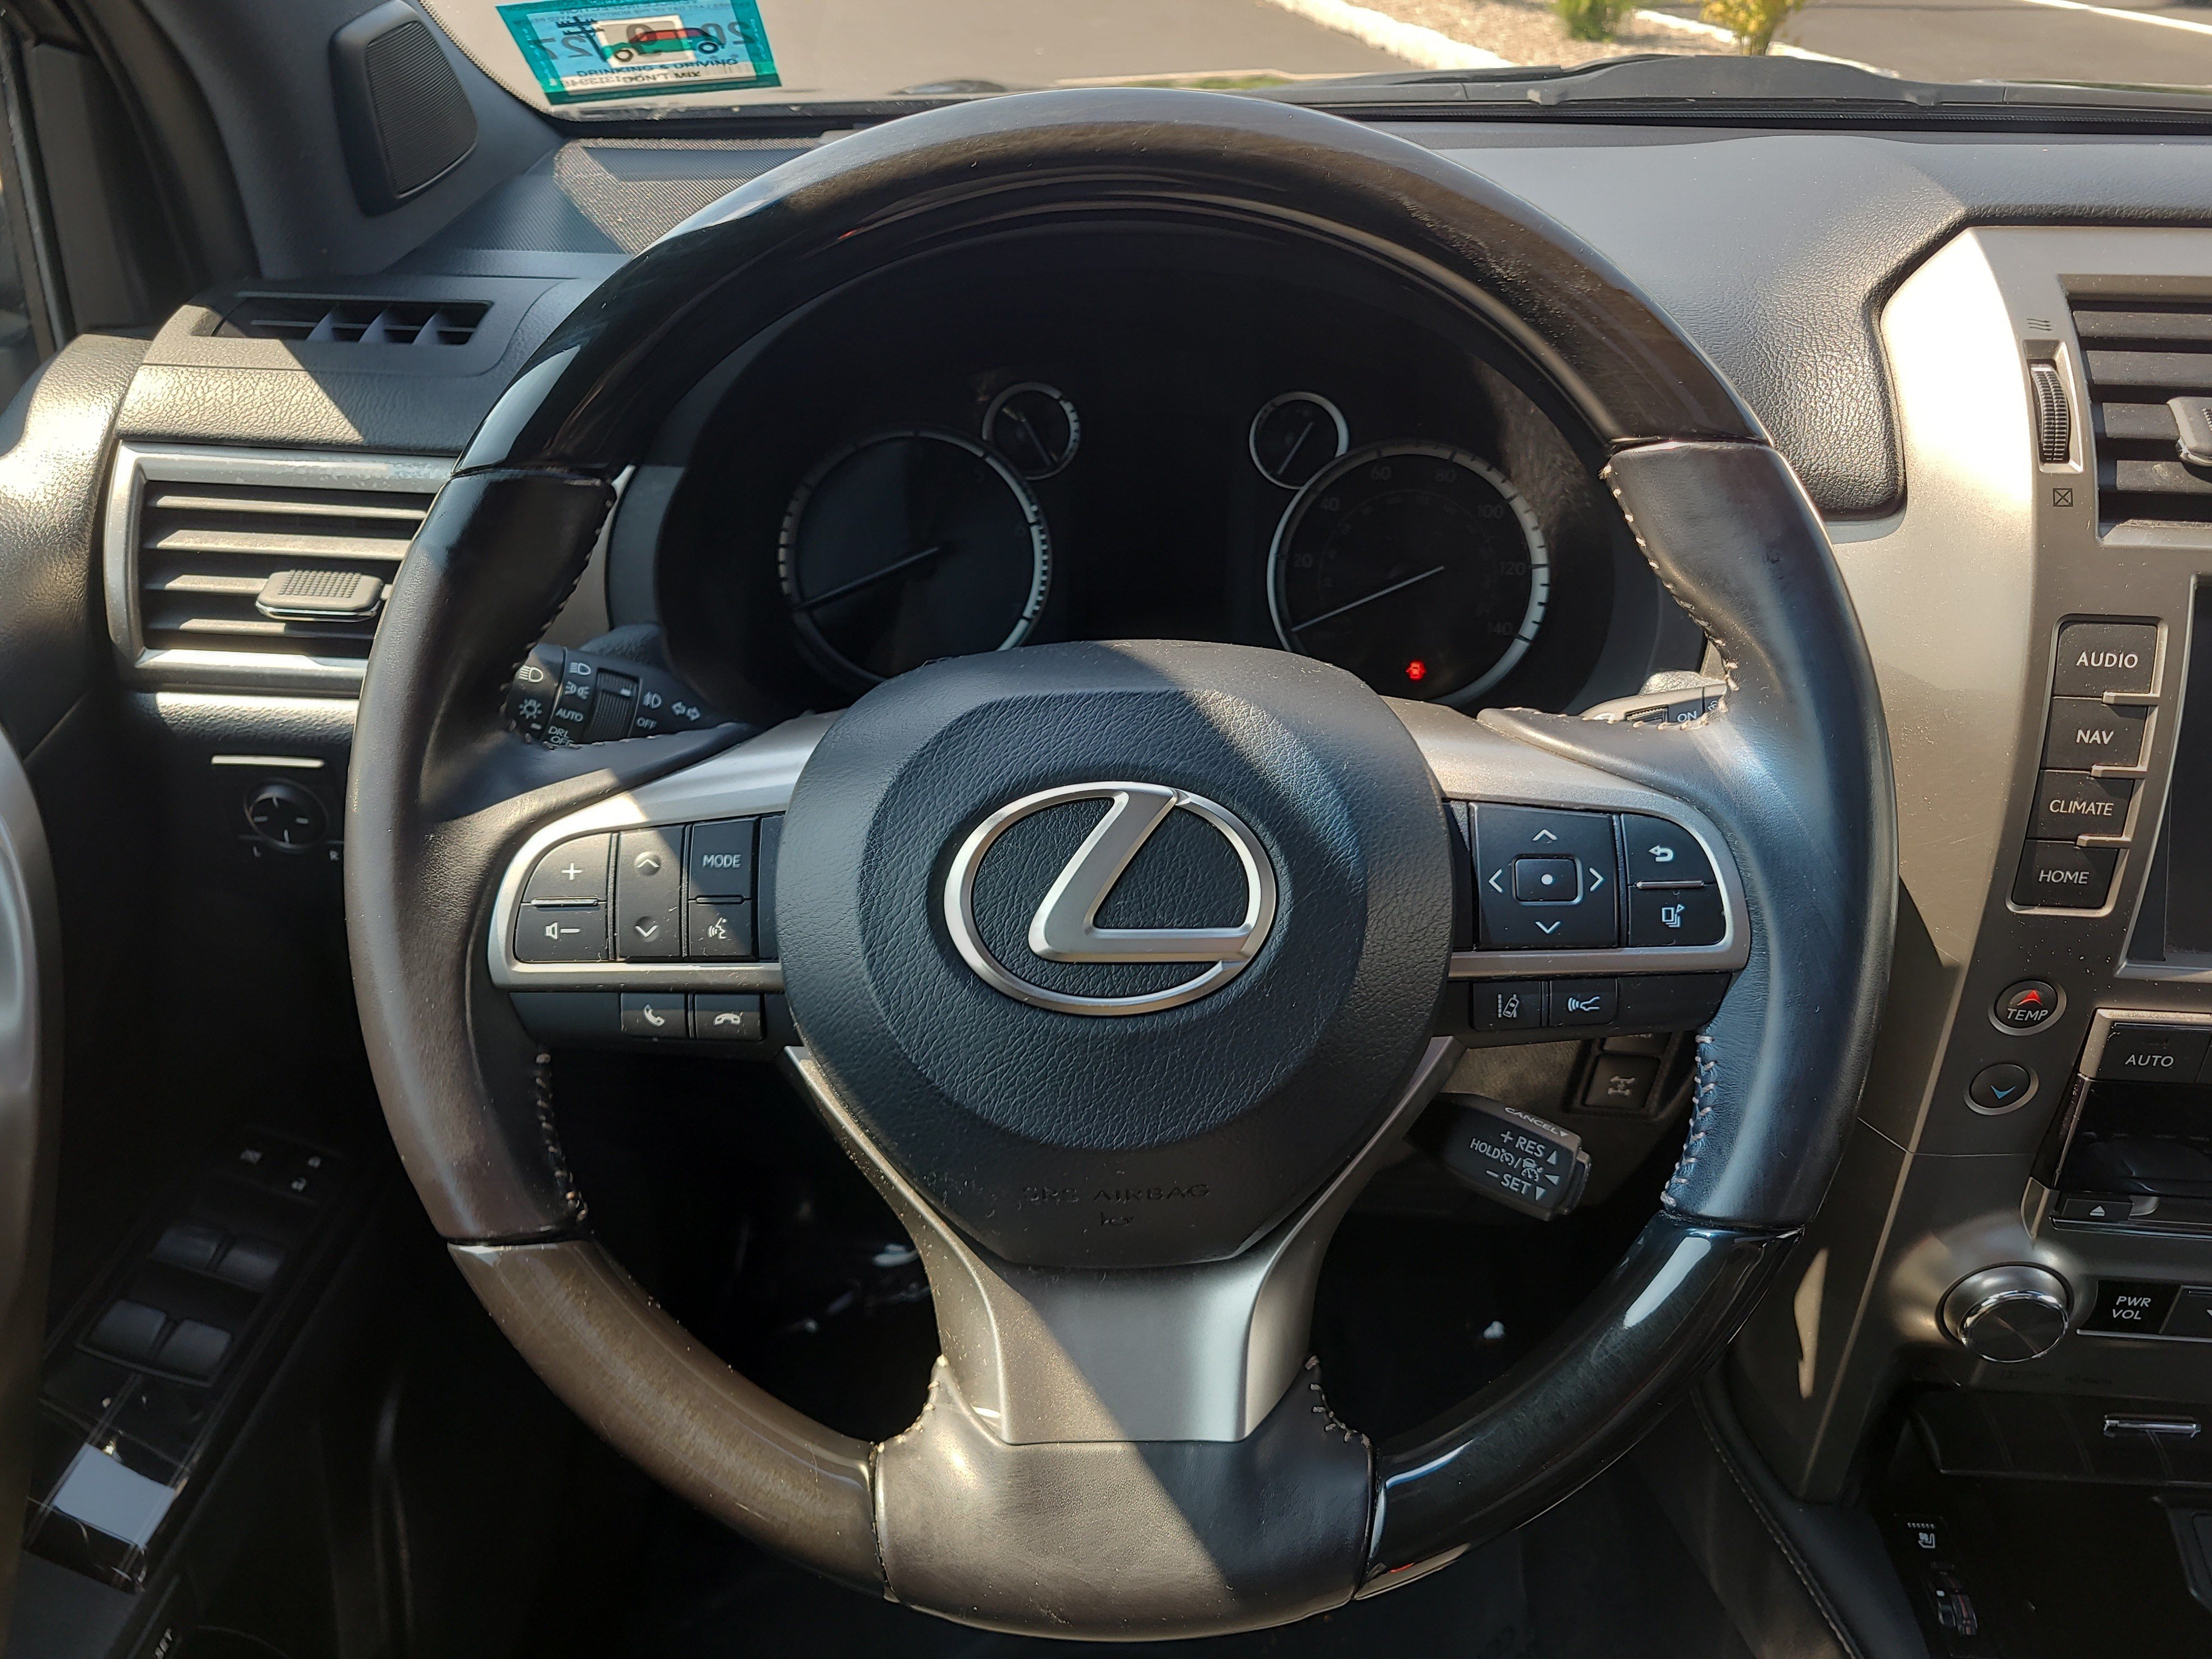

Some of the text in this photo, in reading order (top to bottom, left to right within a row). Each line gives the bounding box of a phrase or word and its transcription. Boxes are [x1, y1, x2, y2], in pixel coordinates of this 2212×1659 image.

[576, 64, 653, 77] DRINKING
[674, 57, 739, 69] DRIVING
[674, 71, 701, 79] MIX
[2076, 651, 2138, 668] AUDIO
[556, 708, 583, 723] AUTO
[636, 716, 657, 731] OFF
[1677, 710, 1697, 723] ON
[548, 725, 570, 739] DRL
[2075, 729, 2114, 745] NAV
[551, 736, 574, 747] OFF
[2049, 798, 2114, 816] CLIMATE
[702, 853, 742, 869] MODE
[2038, 868, 2090, 885] HOME
[2006, 1008, 2049, 1022] TEMP
[2124, 1054, 2175, 1068] AUTO
[1504, 1107, 1559, 1136] CANCEL
[1470, 1137, 1501, 1161] HOLD
[1514, 1135, 1547, 1158] RES
[1500, 1172, 1532, 1196] SET
[1092, 1183, 1210, 1203] AIRBAG
[2115, 1295, 2152, 1308] PWR
[2112, 1308, 2142, 1321] VOL
